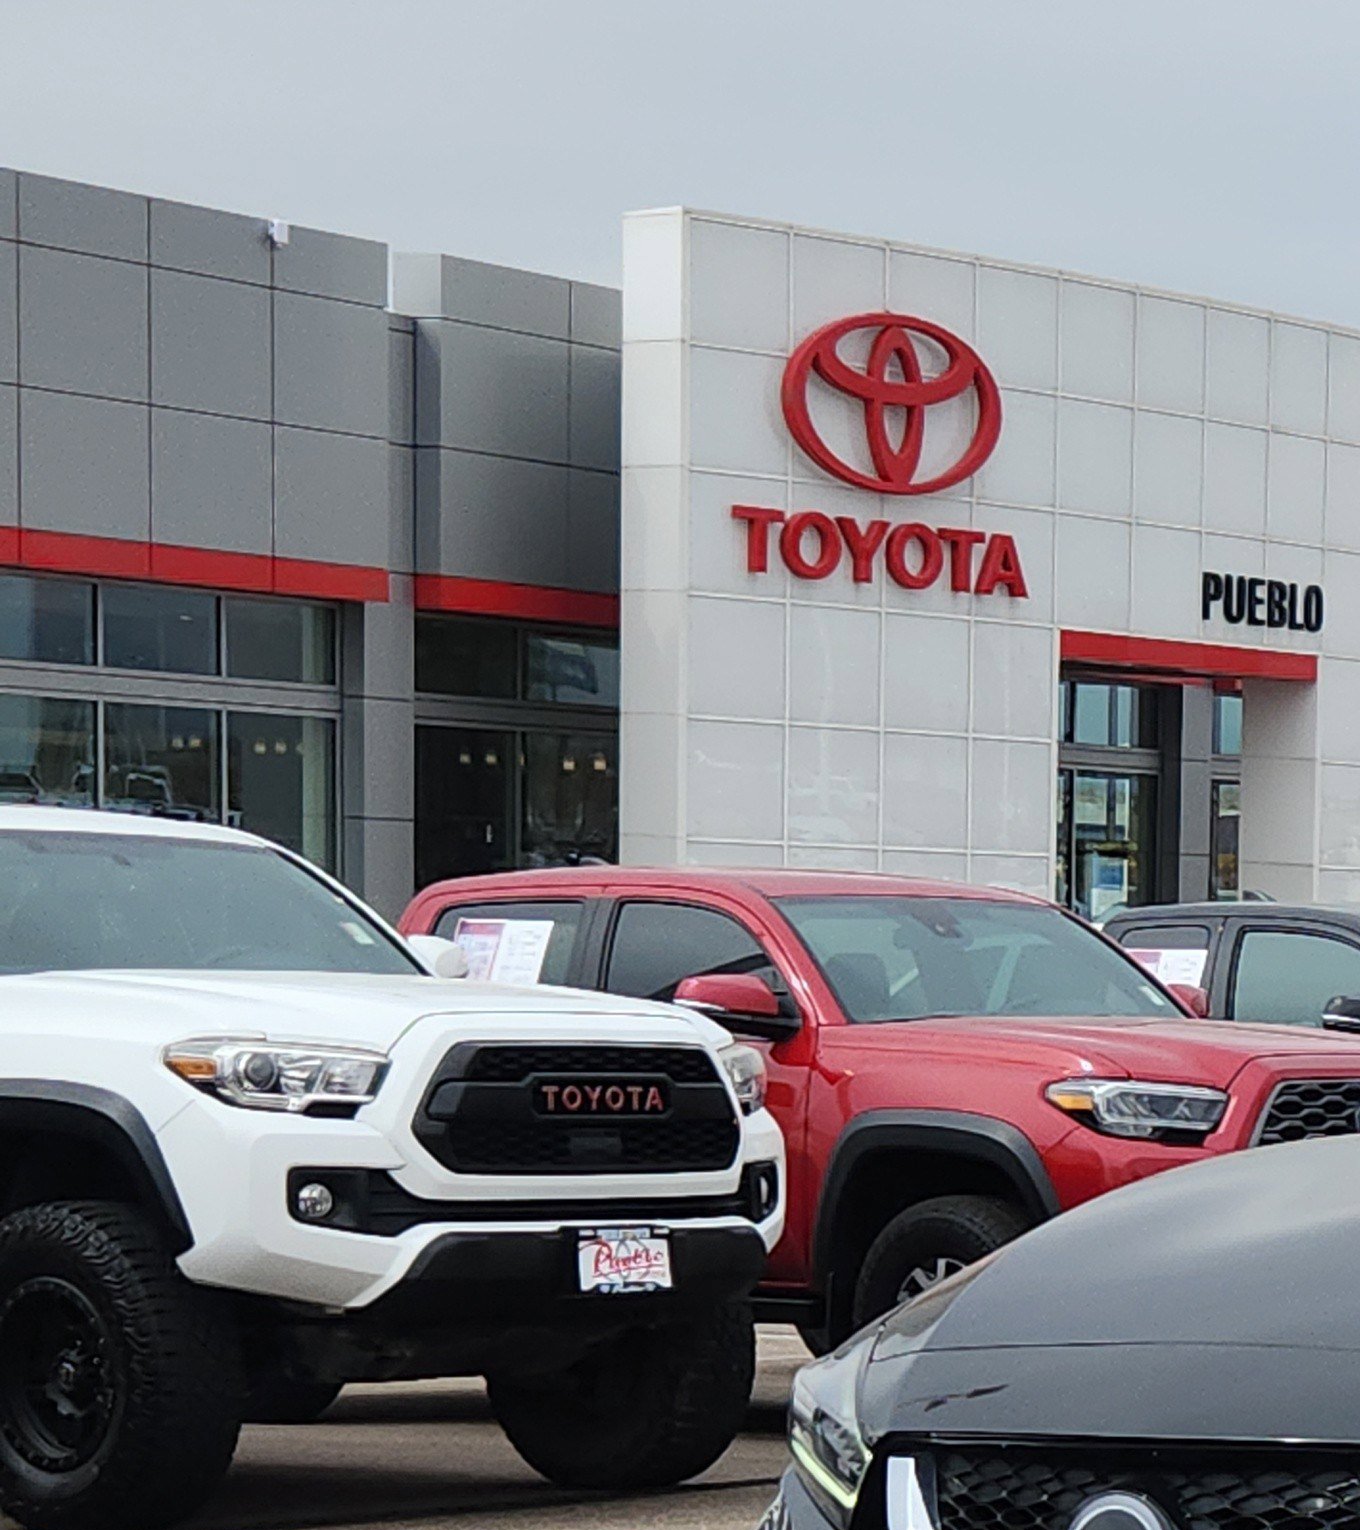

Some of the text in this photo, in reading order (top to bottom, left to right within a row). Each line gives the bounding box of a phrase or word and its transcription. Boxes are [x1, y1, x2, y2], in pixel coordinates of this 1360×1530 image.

[731, 505, 1028, 598] TOYOTA
[1201, 571, 1324, 632] PUEBLO
[541, 1085, 664, 1111] TOYOTA
